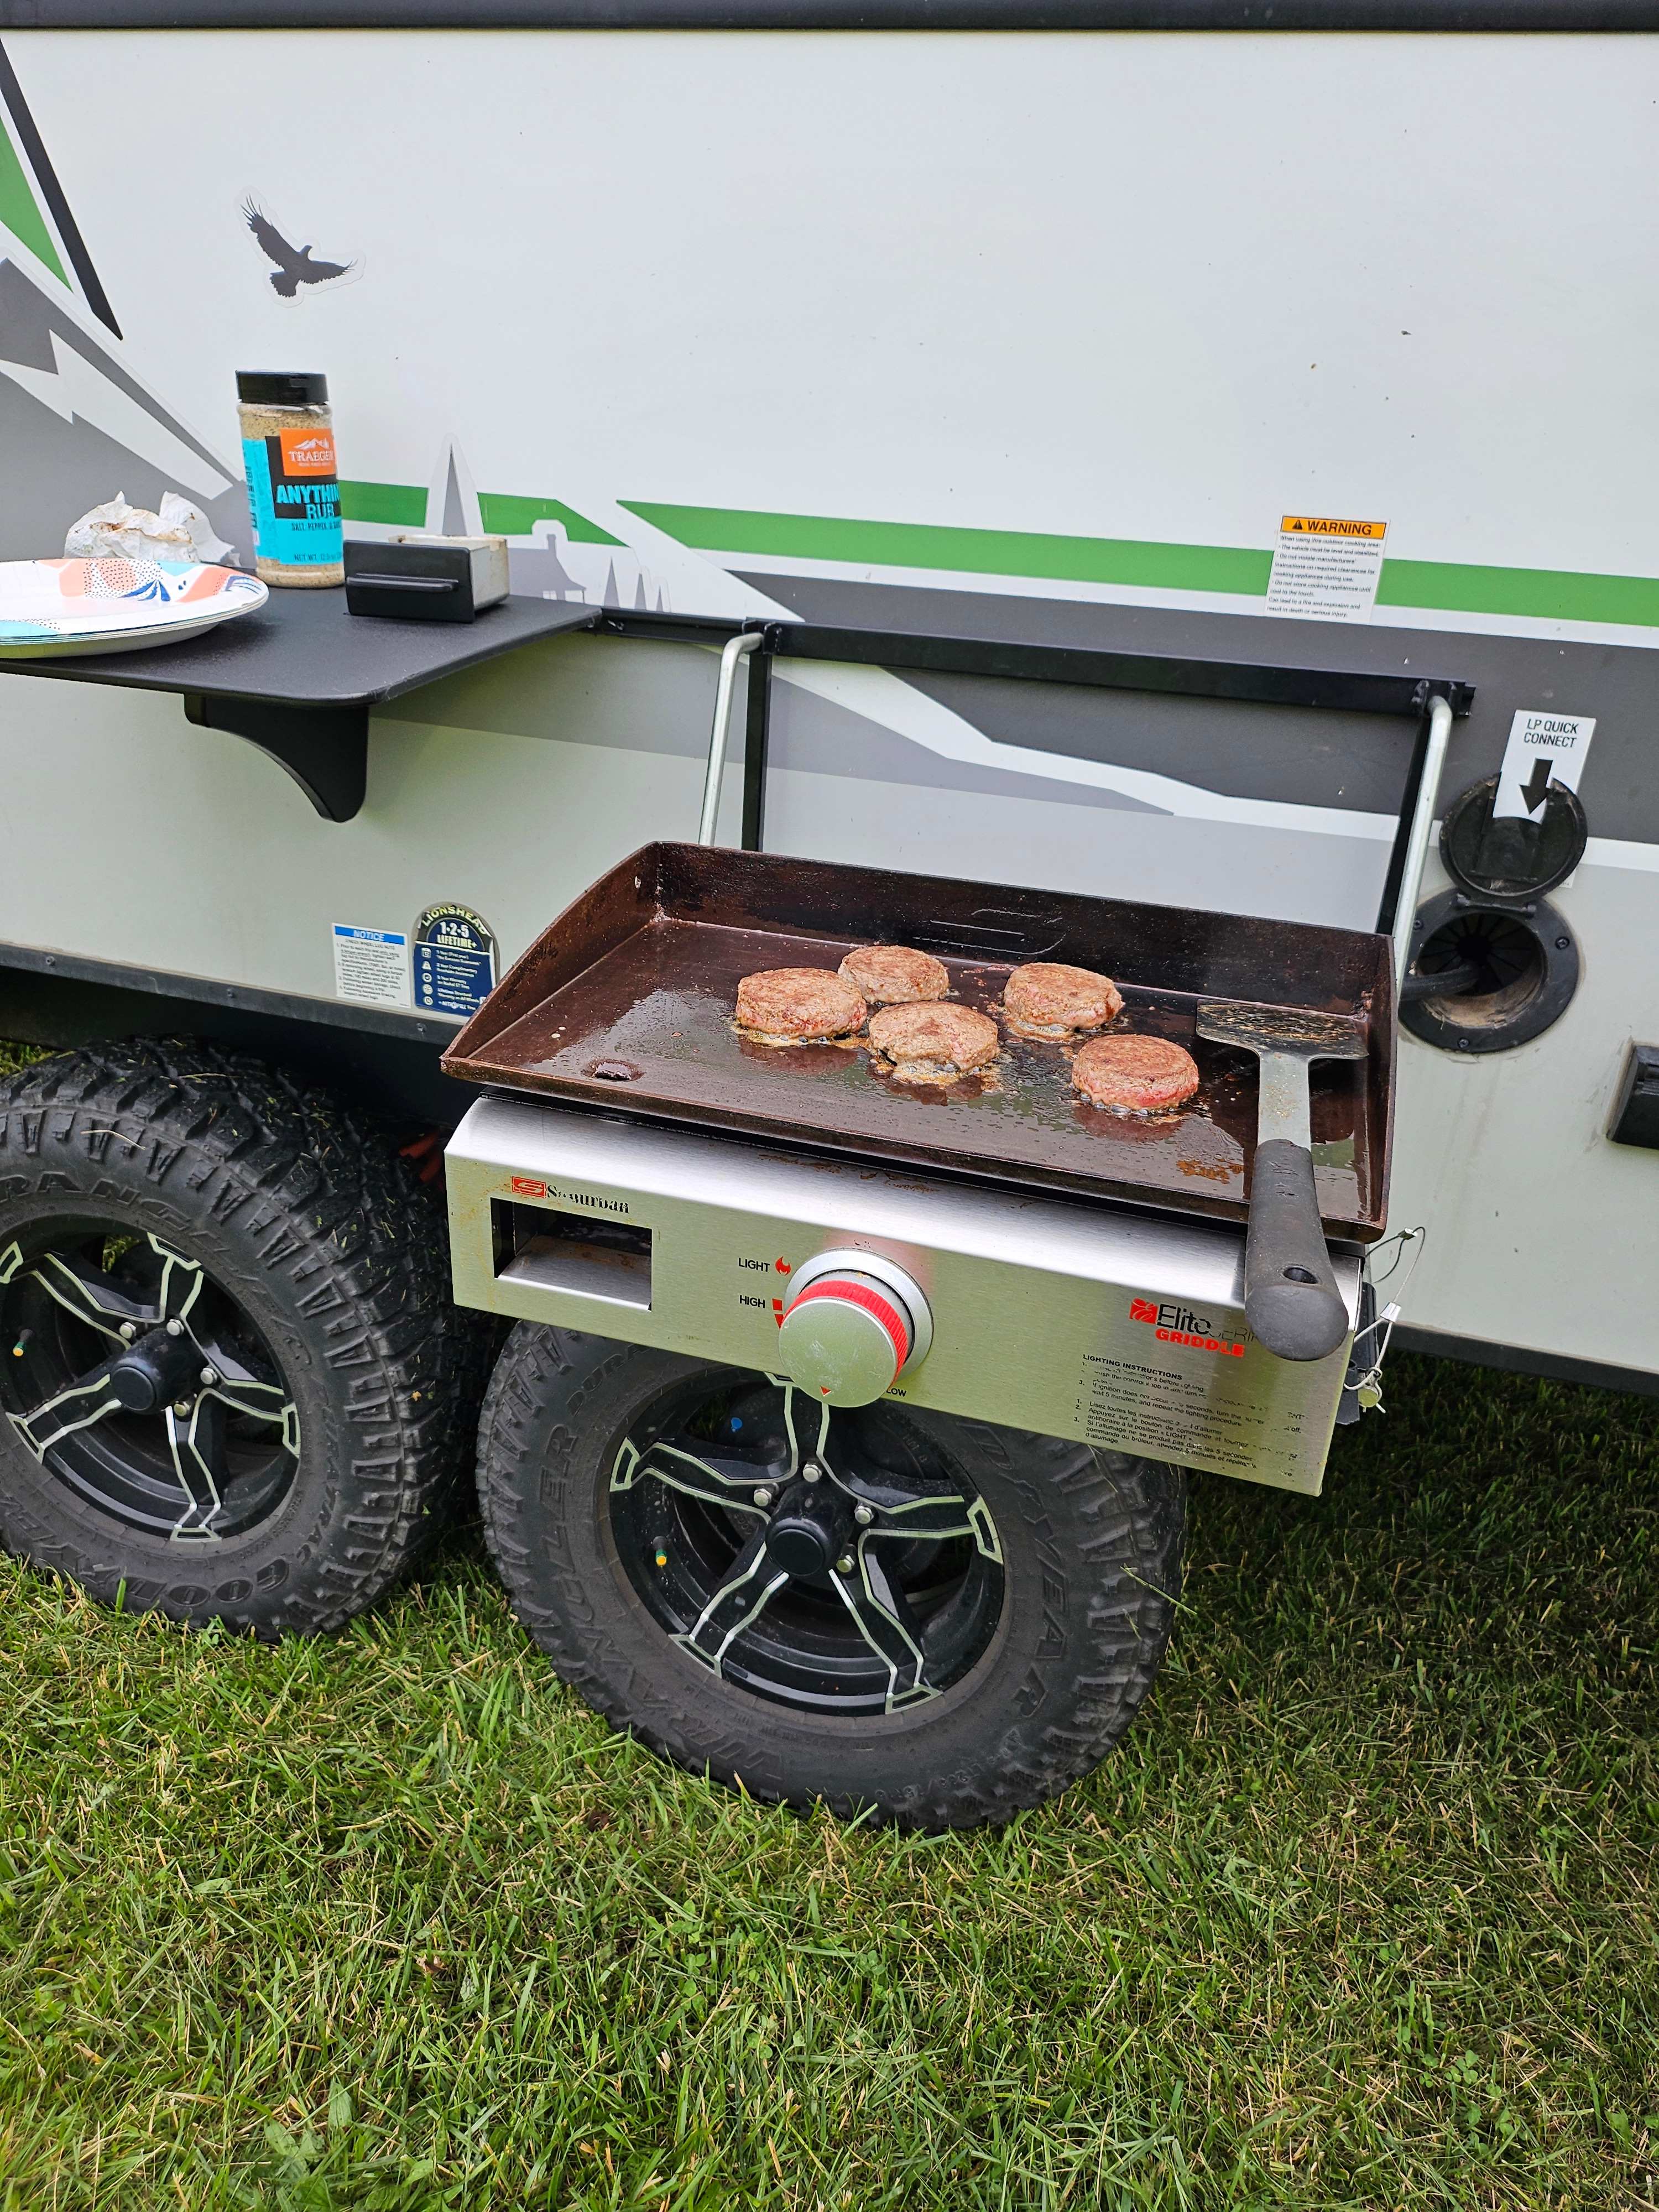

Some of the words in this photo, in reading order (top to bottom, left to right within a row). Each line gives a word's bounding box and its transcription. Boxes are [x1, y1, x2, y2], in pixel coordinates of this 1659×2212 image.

[276, 484, 339, 504] ANYTHIN
[306, 504, 334, 519] RUB
[1308, 520, 1371, 535] WARNING
[1527, 718, 1542, 730] LP
[1544, 720, 1579, 734] QUICK
[1524, 732, 1577, 747] CONNECT
[421, 906, 487, 935] LIONSHEAD
[354, 930, 385, 941] NOTICE
[547, 1185, 629, 1214] Surban
[738, 1258, 770, 1272] LIGHT
[739, 1295, 765, 1308] HIGH
[1155, 1328, 1244, 1358] GRIDDLE
[1083, 1354, 1120, 1367] LIGHTING
[1122, 1363, 1183, 1380] INSTRUCTIONS
[1098, 1384, 1121, 1393] ignition
[1122, 1389, 1138, 1397] does
[1089, 1401, 1106, 1410] Lisez
[1107, 1405, 1126, 1414] toutes
[1152, 1402, 1173, 1412] repeat
[1186, 1410, 1208, 1420] lighting
[1088, 1408, 1115, 1418] Appuyez
[1140, 1419, 1162, 1428] bouton
[1176, 1428, 1212, 1439] commande
[1086, 1427, 1120, 1438] commande
[1134, 1424, 1159, 1435] position
[1166, 1431, 1187, 1440] LIGHT
[954, 1420, 1070, 1719] DYEAR
